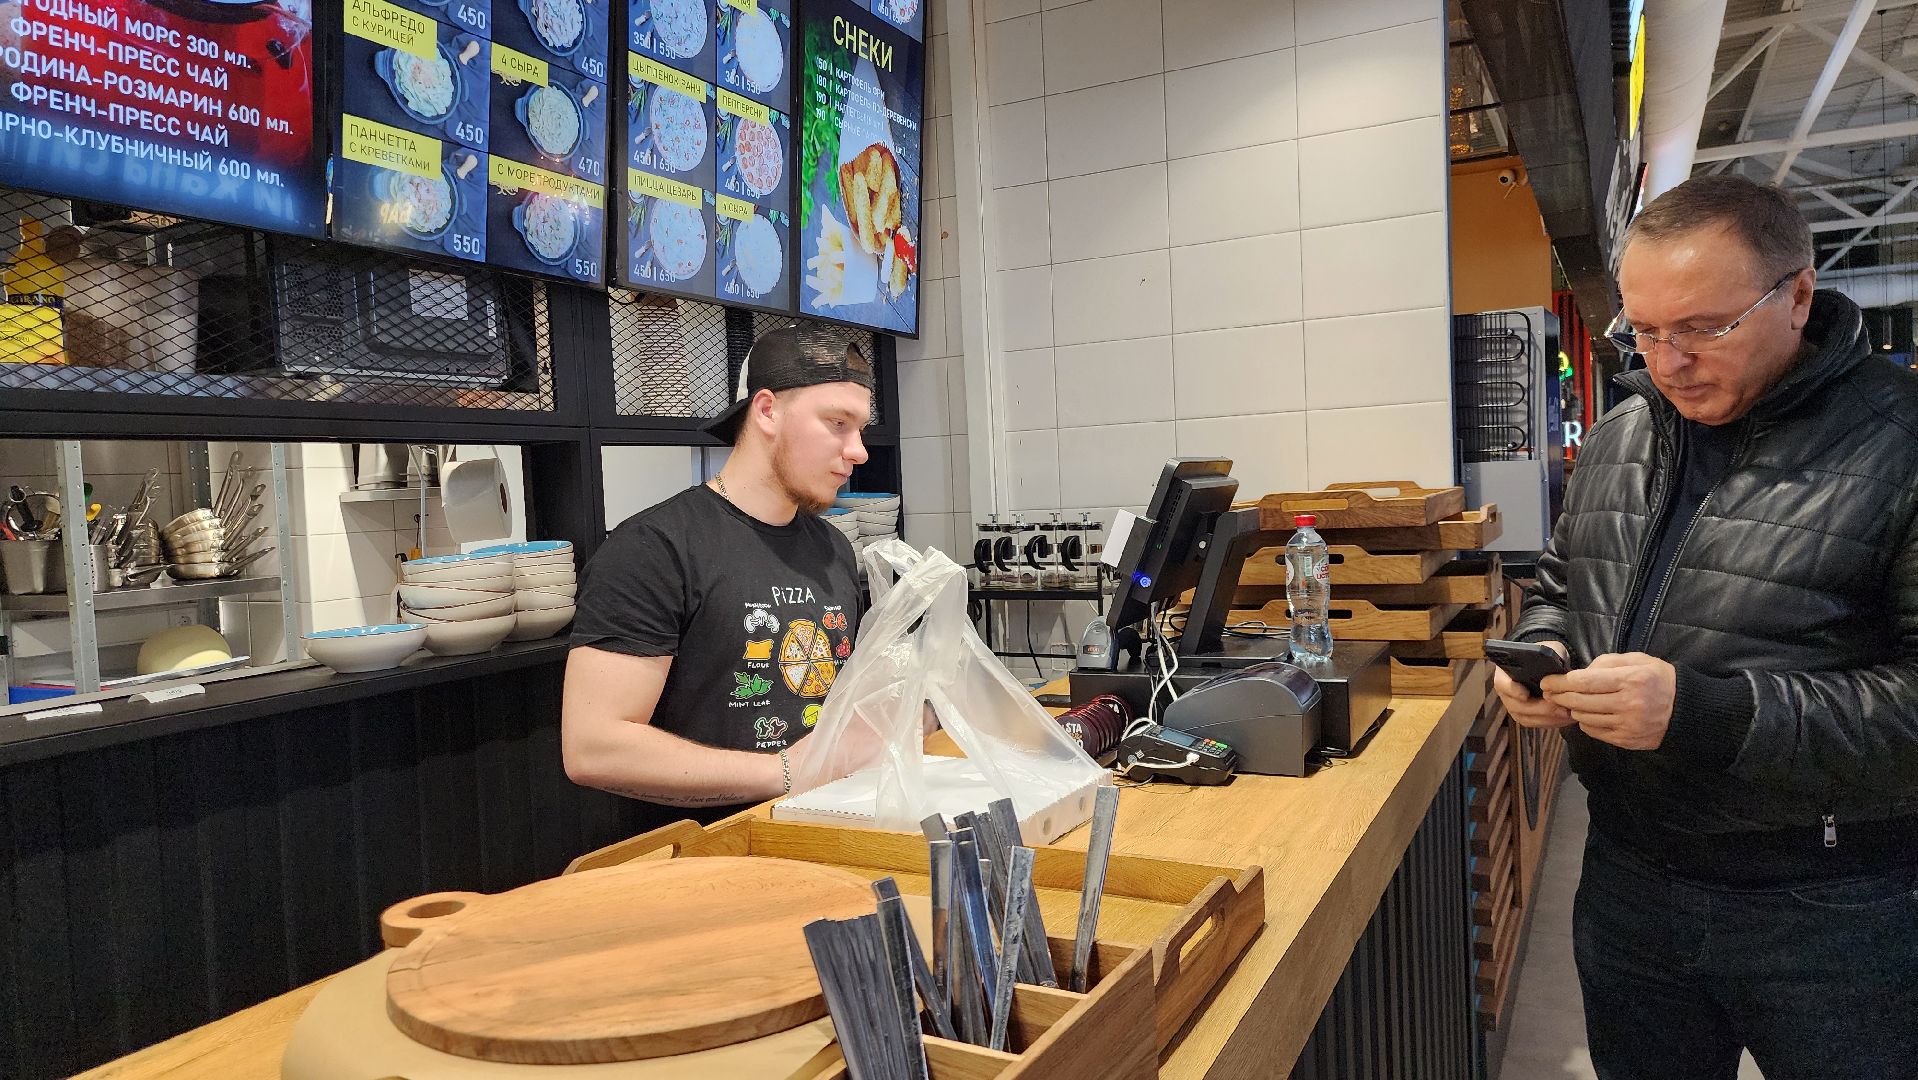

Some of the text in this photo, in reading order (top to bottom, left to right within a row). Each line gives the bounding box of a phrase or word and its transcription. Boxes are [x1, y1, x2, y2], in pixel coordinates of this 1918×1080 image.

[352, 0, 425, 35] АЛЬФРЕДО
[352, 16, 415, 46] С КУРИЦЕЙ
[457, 4, 486, 30] 450
[10, 16, 229, 92] ФРЕНЧ-ПРЕСС ЧАЙ
[124, 16, 182, 49] МОРС
[186, 35, 219, 60] 300
[224, 50, 252, 70] мл.
[659, 44, 676, 60] 550
[833, 15, 893, 73] СНЕКИ
[501, 54, 539, 77] 4 СЫРА
[581, 56, 604, 78] 450
[0, 45, 294, 136] ОДИНА-РОЗМАРИН 600 мл.
[10, 81, 229, 149] ФРЕНЧ-ПРЕСС ЧАЙ
[350, 124, 417, 153] ПАНЧЕТТА
[455, 120, 484, 145] 450
[0, 108, 213, 173] РНО-КЛУБНИЧНЫЙ
[218, 157, 251, 181] 600
[256, 170, 285, 188] мл.
[349, 141, 430, 172] С КРЕВЕТКАМИ
[578, 156, 600, 177] 470
[497, 163, 600, 200] С МОРЕПРОДУКТАМИ
[634, 175, 697, 202] ПИЦЦА ЦЕЗАРЬ
[453, 234, 480, 256] 550
[575, 258, 598, 277] 550
[747, 661, 770, 669] FLOUR
[756, 740, 788, 748] PEPPER
